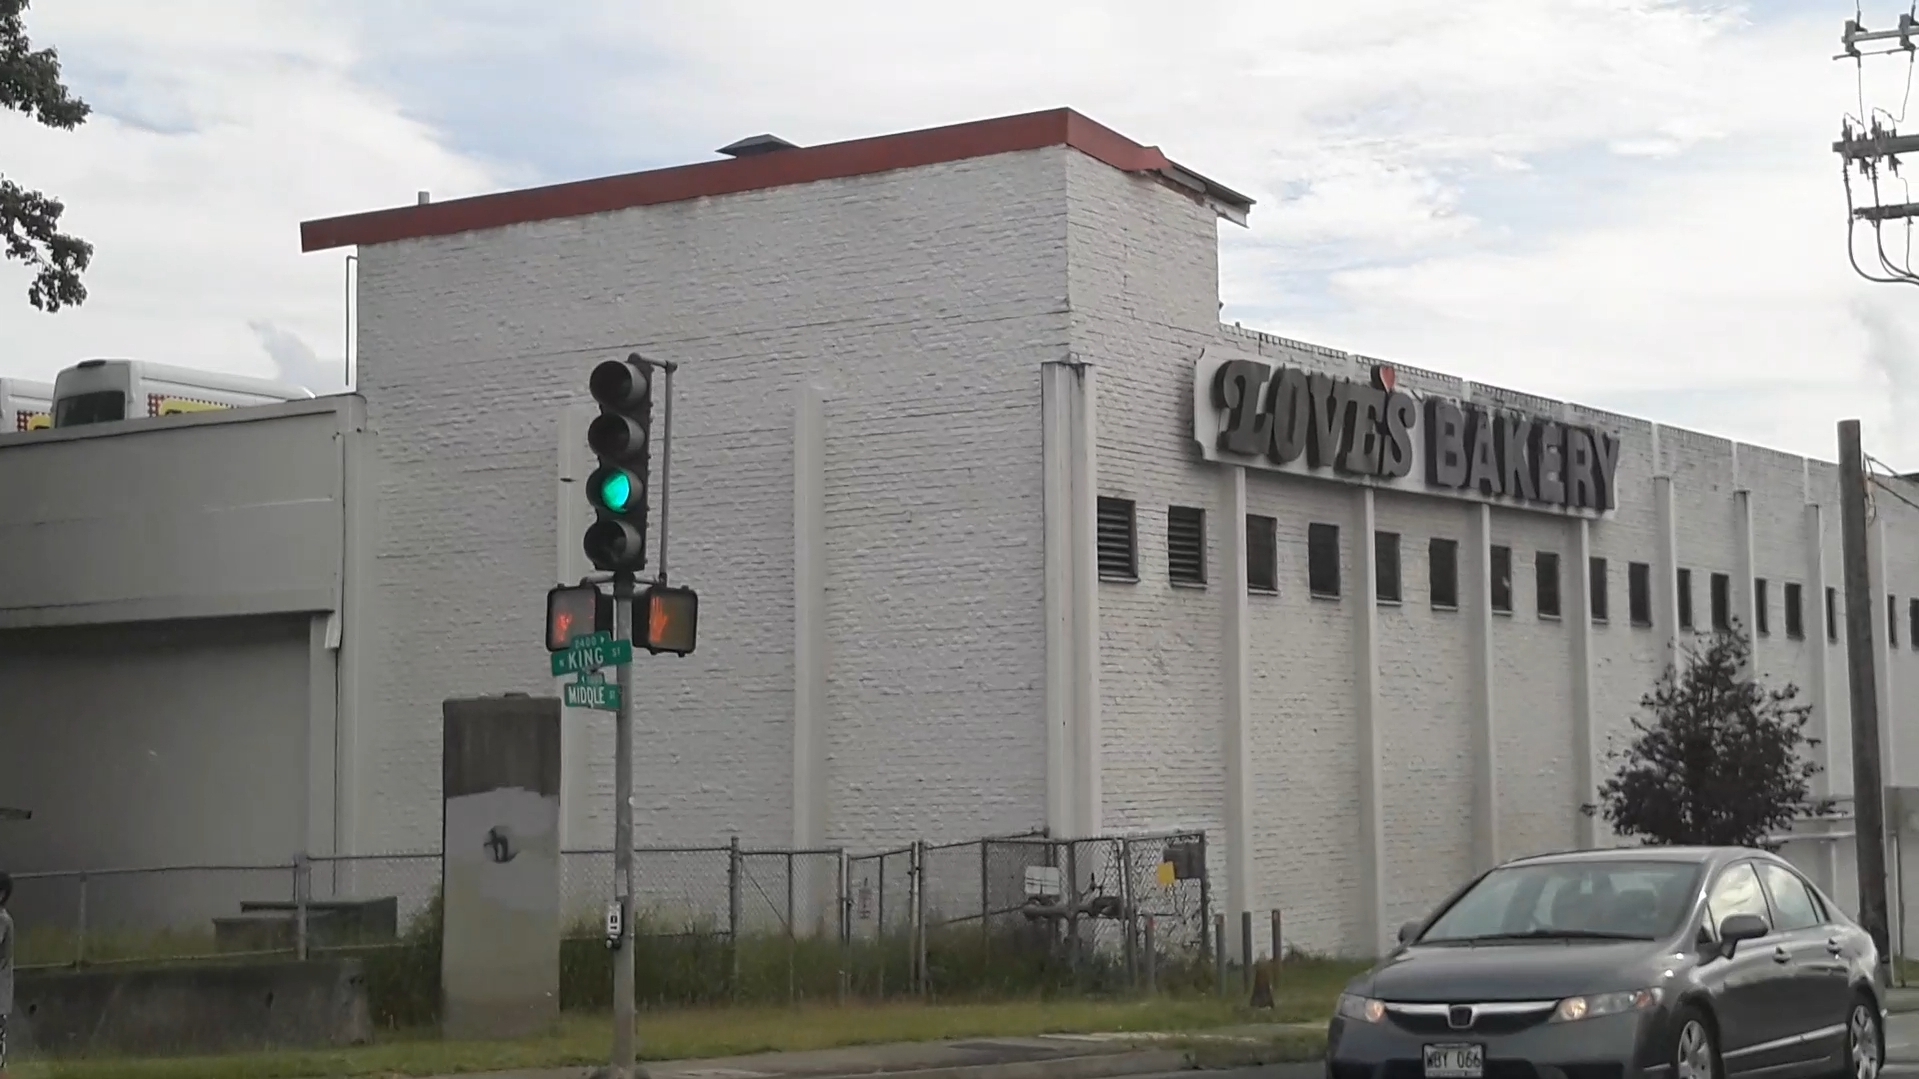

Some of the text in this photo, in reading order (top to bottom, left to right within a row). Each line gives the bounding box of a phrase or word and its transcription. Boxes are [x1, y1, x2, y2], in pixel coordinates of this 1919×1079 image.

[1425, 395, 1620, 512] BAKERY
[575, 636, 597, 649] 2400
[568, 647, 604, 669] KING
[568, 686, 606, 705] MIDDLE
[1457, 1051, 1481, 1069] 066
